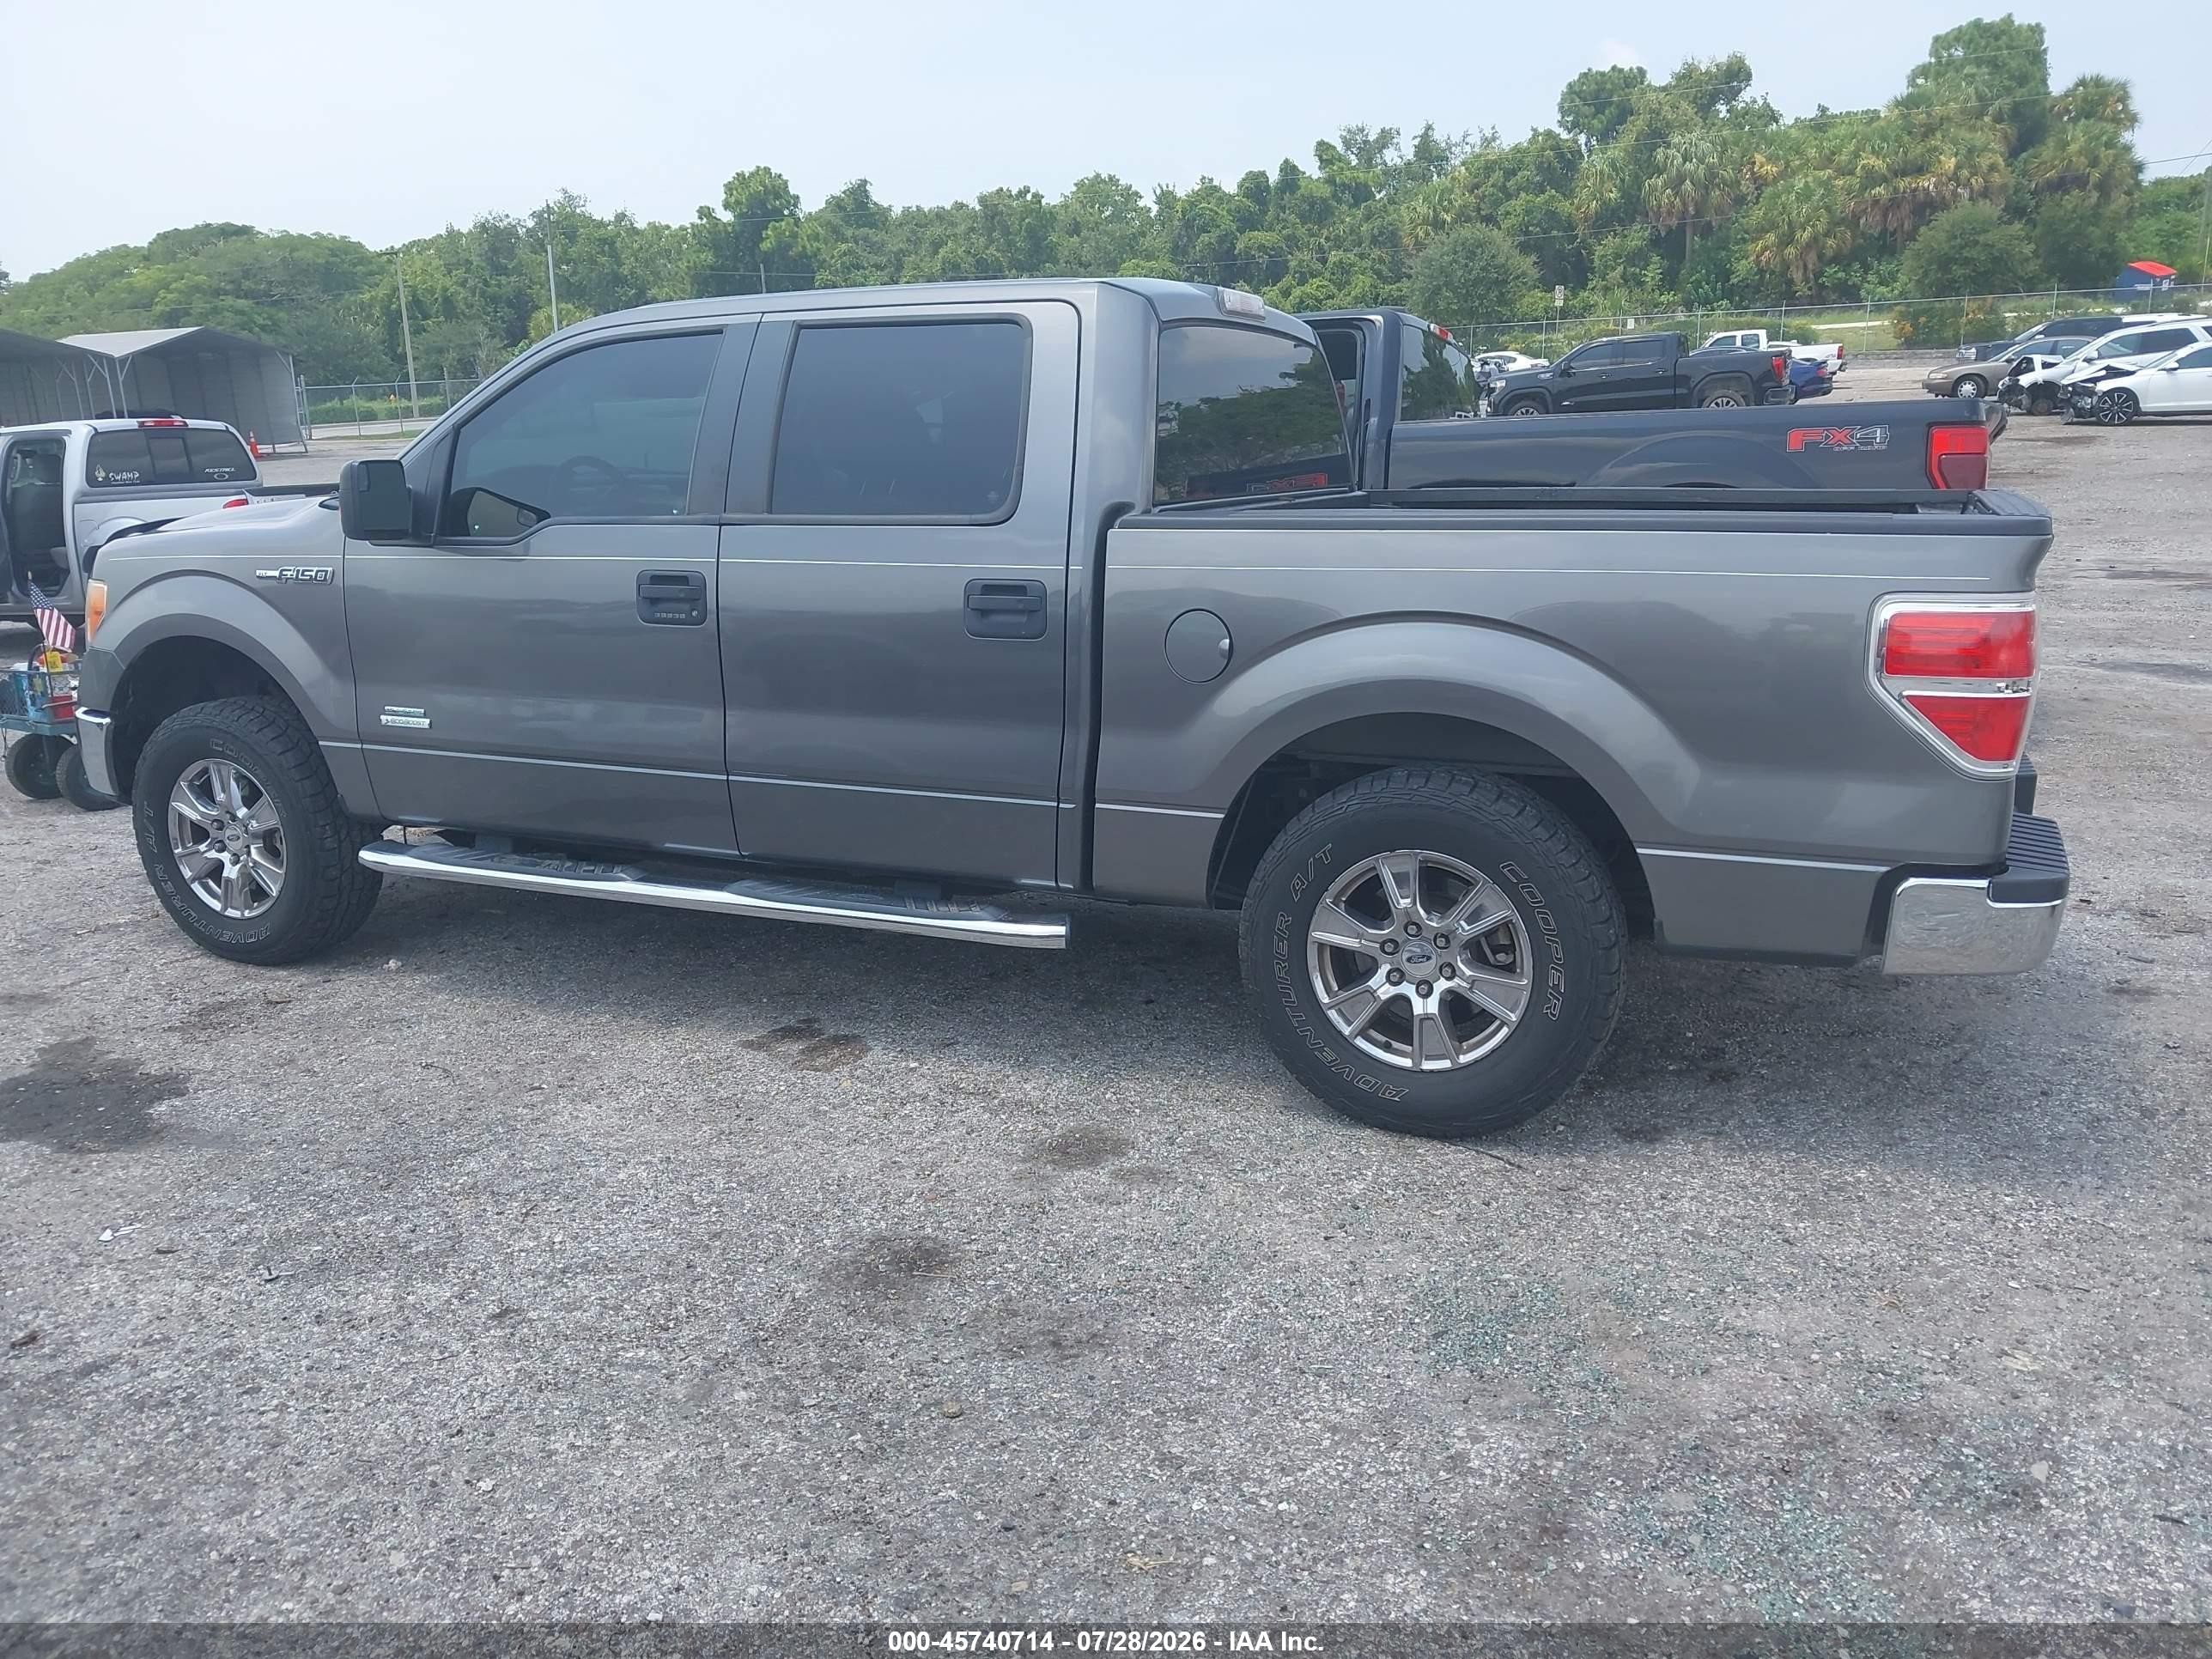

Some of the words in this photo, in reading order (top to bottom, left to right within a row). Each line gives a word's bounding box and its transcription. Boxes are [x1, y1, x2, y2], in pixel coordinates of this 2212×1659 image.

[1787, 425, 1889, 452] FX4
[109, 471, 140, 482] SWAMP
[276, 567, 334, 585] F-150
[1291, 842, 1334, 902] A/T
[154, 863, 271, 944] ADVENTURER
[1498, 860, 1565, 1022] COOPER
[1271, 911, 1411, 1103] ADVENTURER
